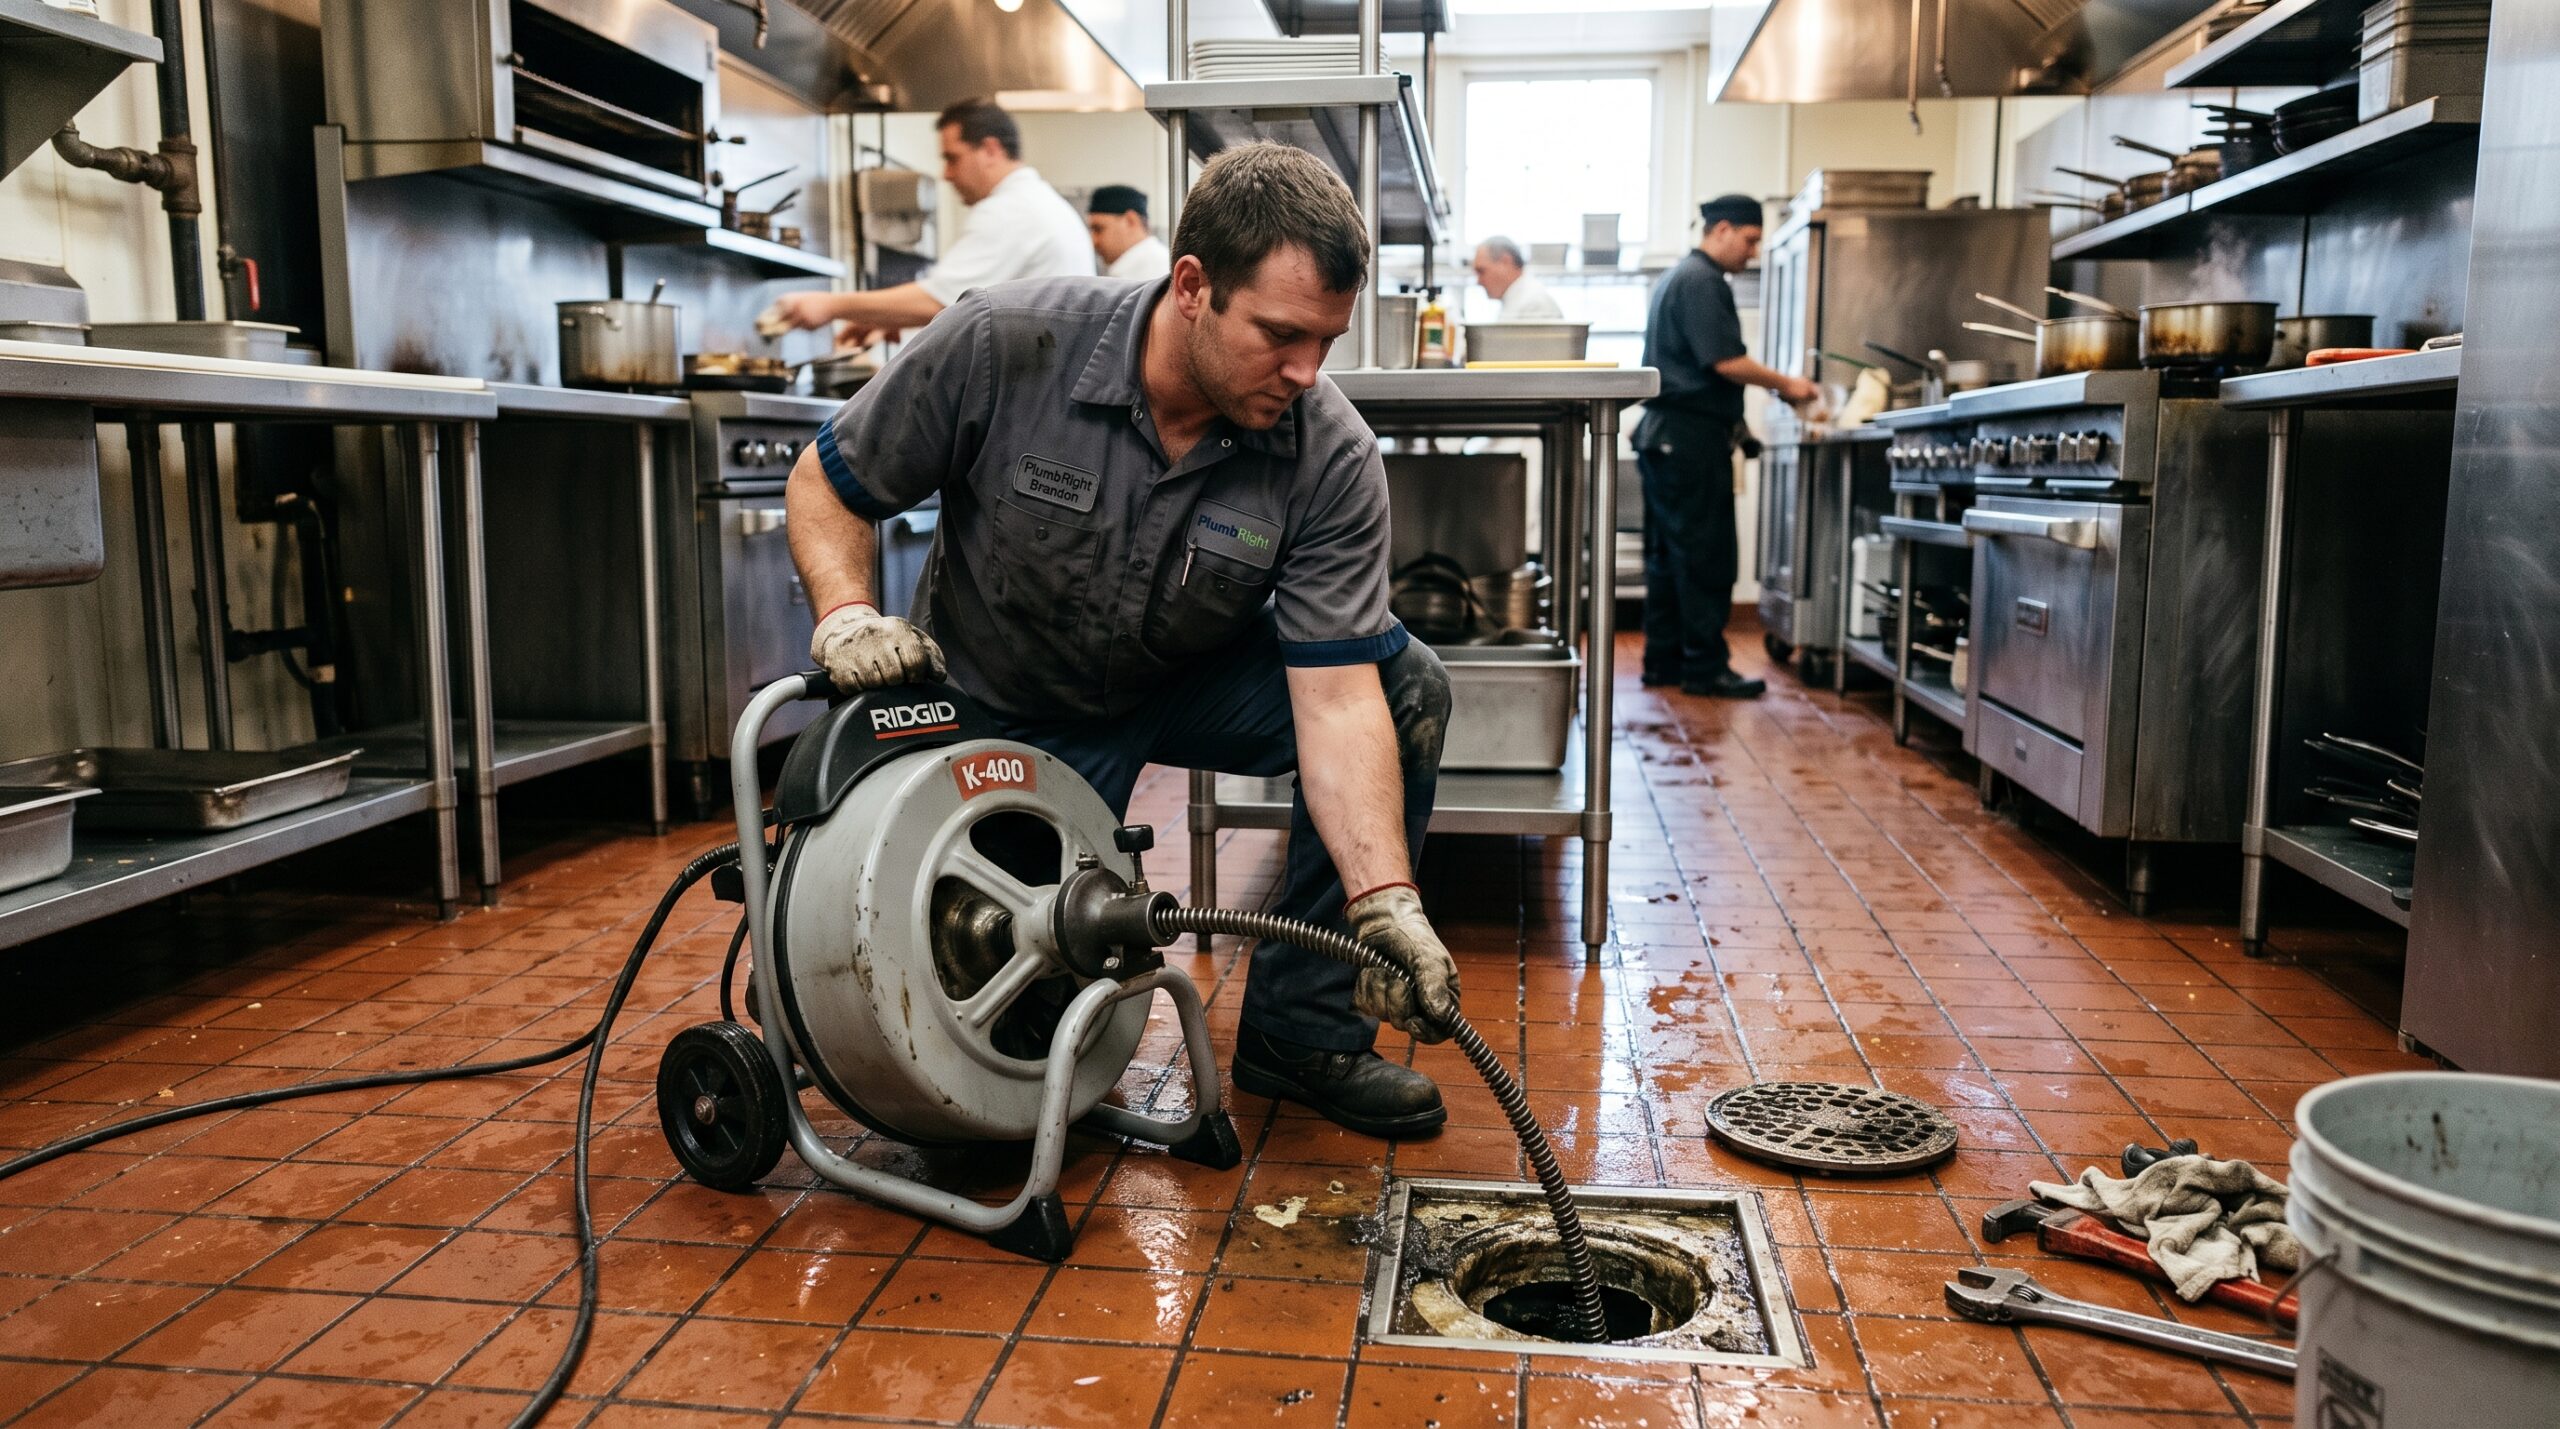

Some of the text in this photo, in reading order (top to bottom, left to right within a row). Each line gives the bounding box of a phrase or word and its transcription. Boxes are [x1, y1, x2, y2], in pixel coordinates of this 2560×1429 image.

[1024, 462, 1093, 492] PlumbRight
[1030, 479, 1079, 503] Brandon
[1198, 514, 1270, 550] PlumbRight
[870, 701, 956, 731] RIDGID
[961, 758, 1025, 790] K-400
